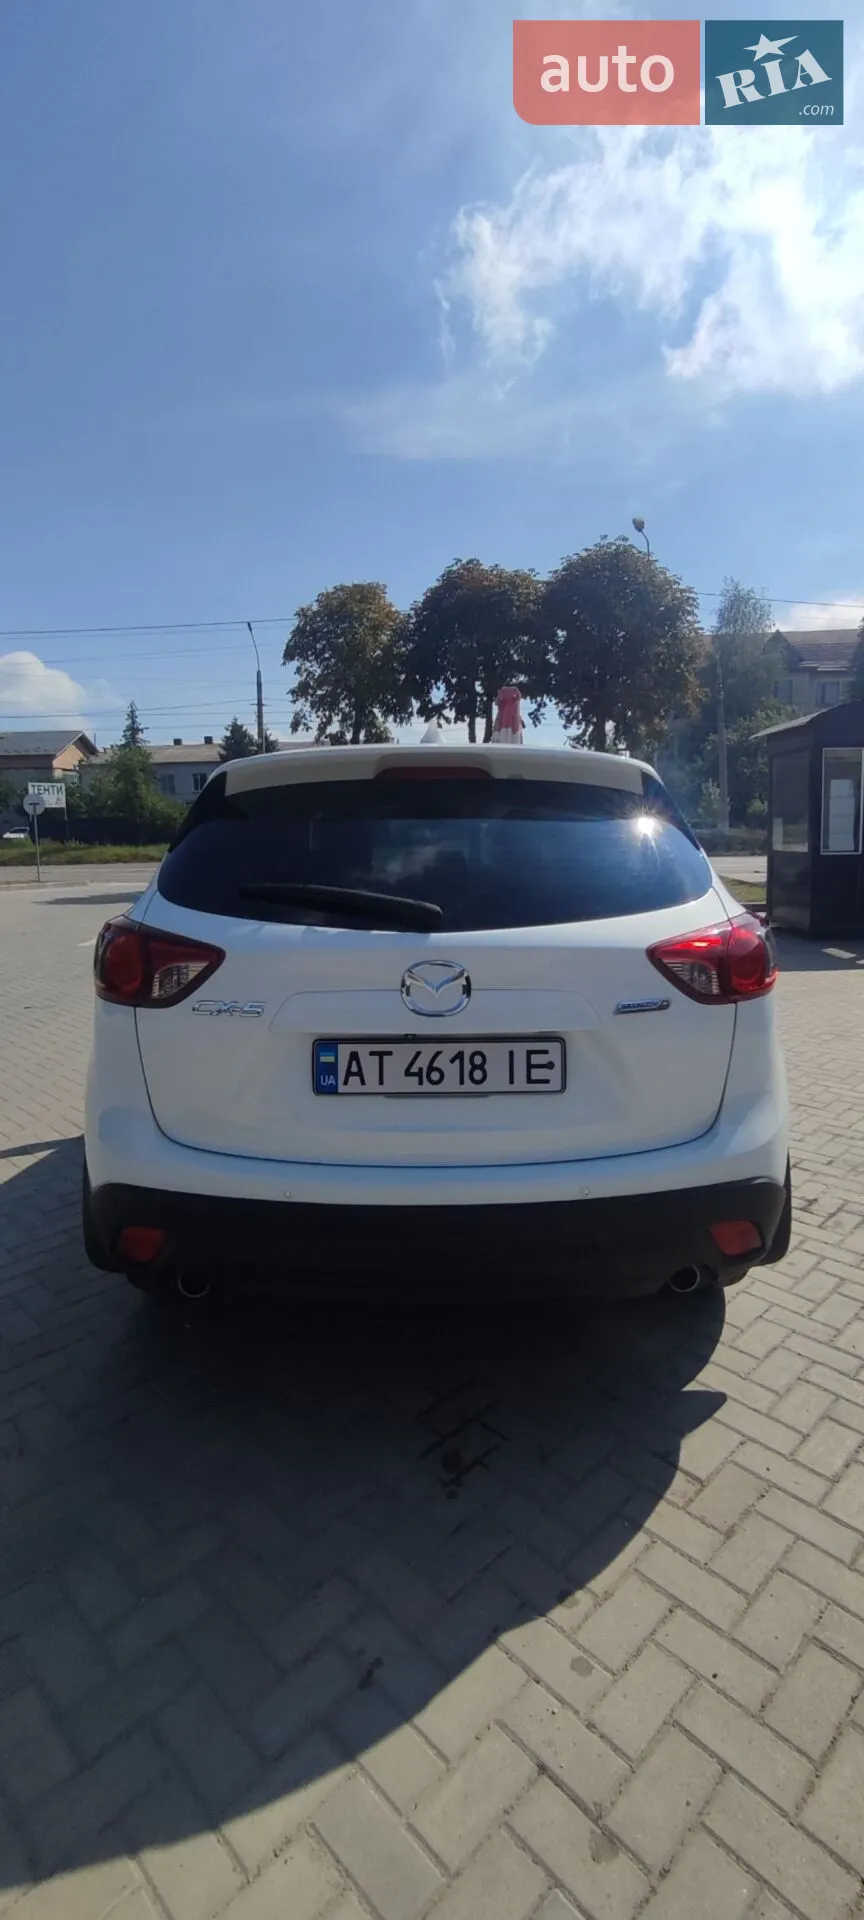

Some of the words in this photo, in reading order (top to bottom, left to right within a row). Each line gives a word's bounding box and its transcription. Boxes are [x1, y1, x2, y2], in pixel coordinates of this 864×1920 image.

[30, 784, 64, 796] ТЕНТИ
[191, 1000, 266, 1018] CX-5
[343, 1050, 393, 1086] AT
[404, 1050, 488, 1086] 4618
[508, 1049, 553, 1085] IE
[320, 1075, 336, 1086] UA
